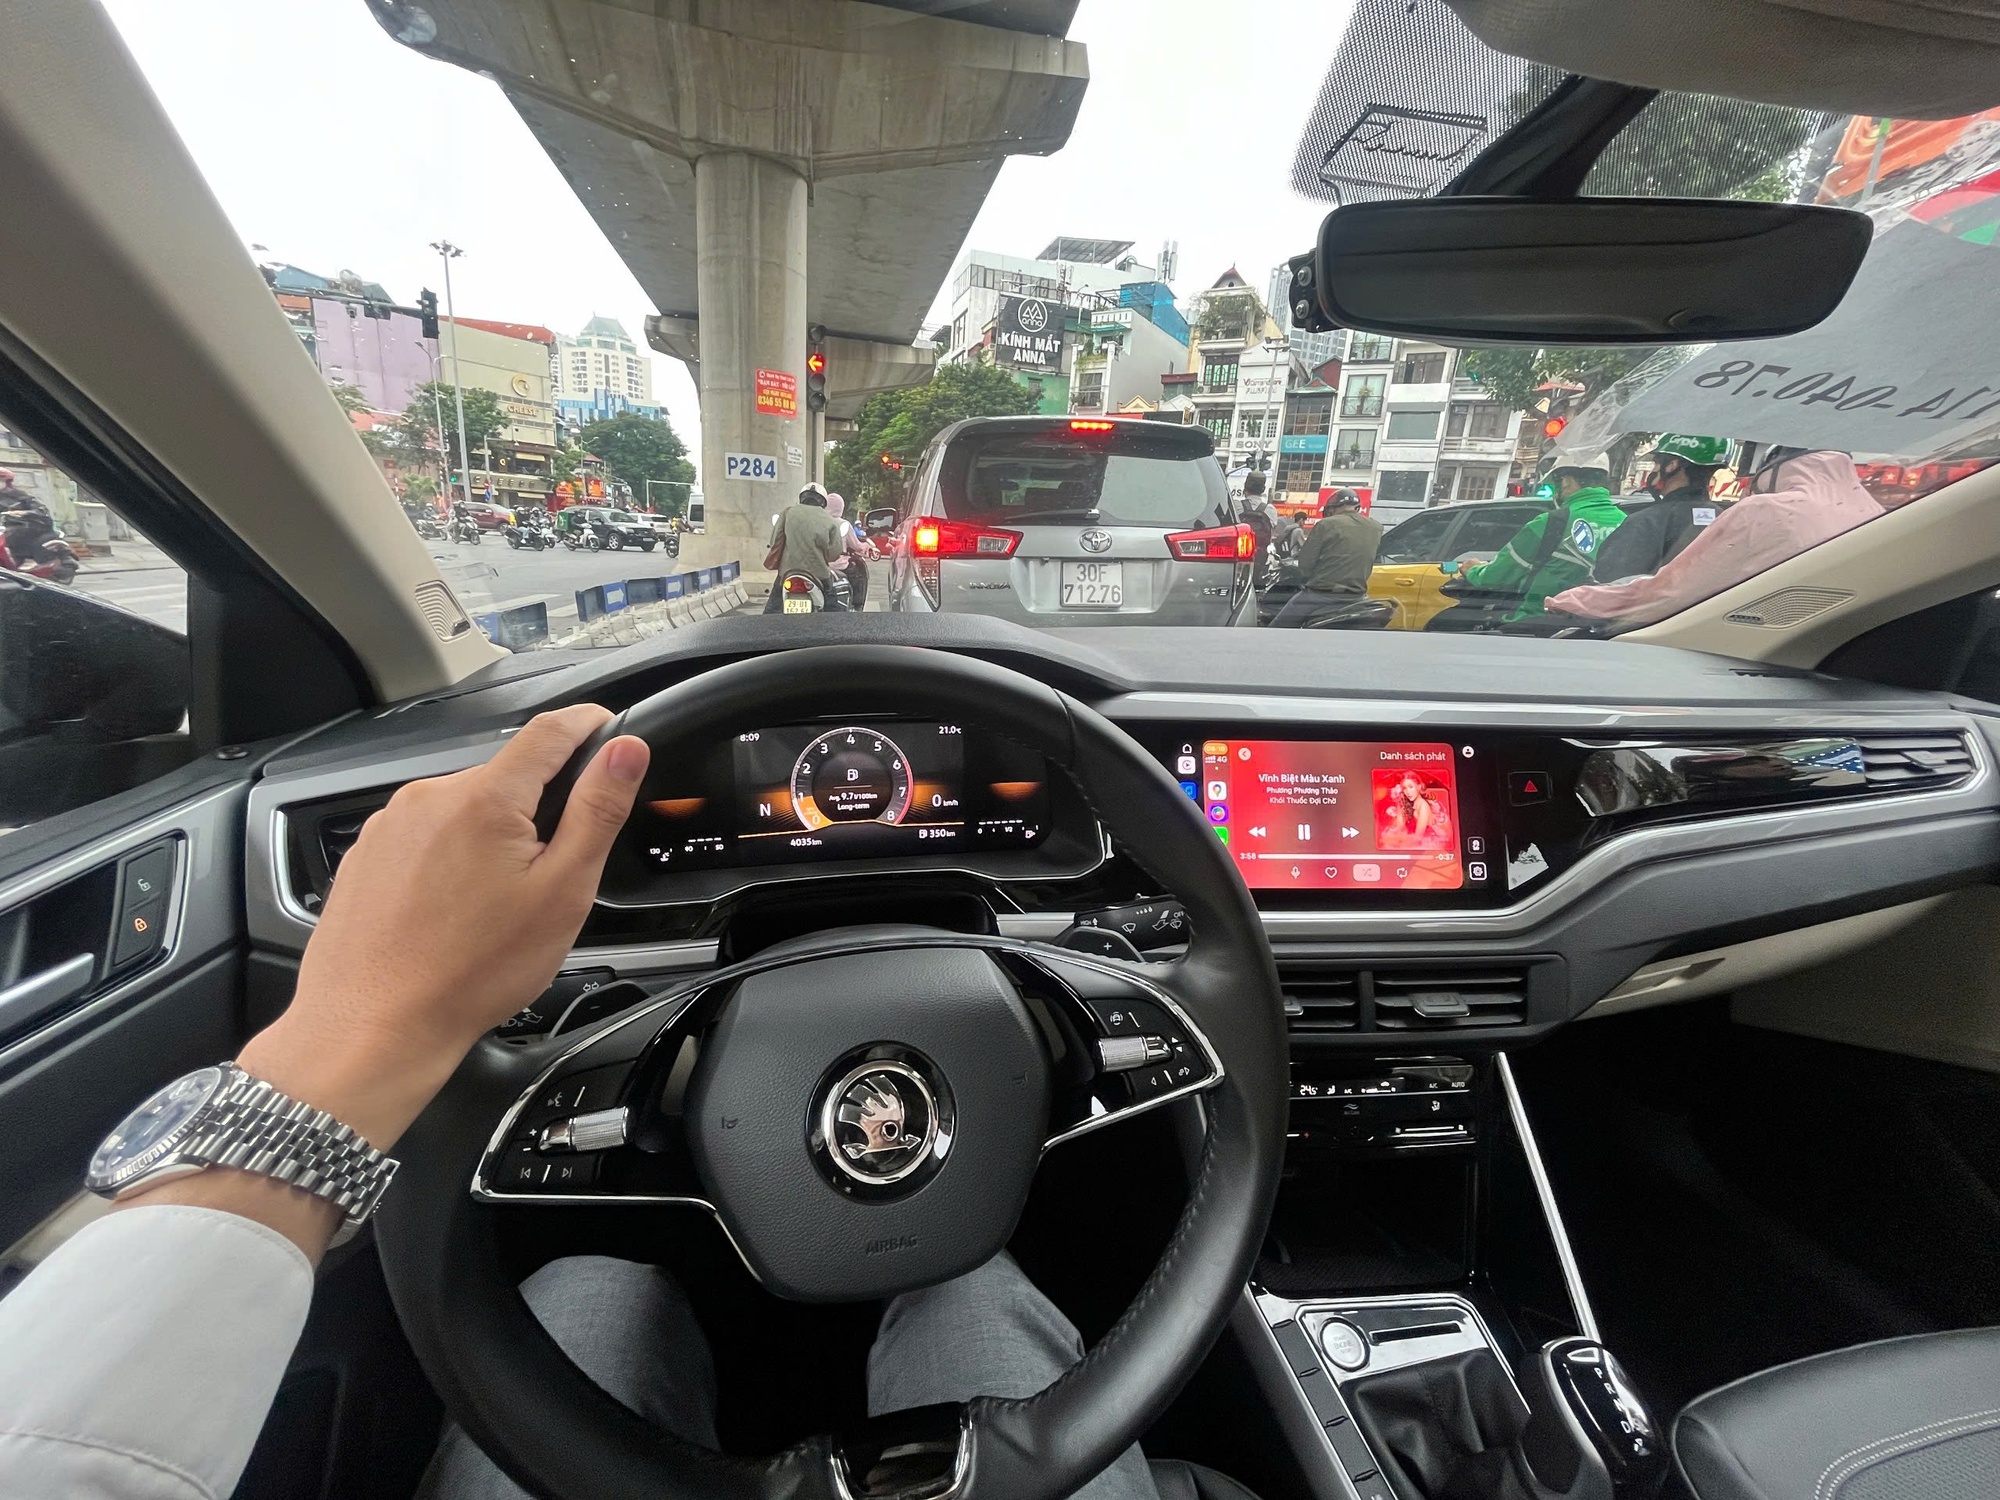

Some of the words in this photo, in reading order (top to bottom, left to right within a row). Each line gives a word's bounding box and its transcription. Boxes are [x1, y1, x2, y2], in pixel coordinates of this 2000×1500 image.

[1001, 330, 1031, 349] KÍNH
[1035, 334, 1061, 353] MẮT
[1013, 349, 1046, 365] ANNA
[1236, 441, 1272, 449] SONY
[1669, 433, 1699, 448] Grab
[727, 456, 776, 478] P284
[1076, 563, 1107, 584] 30F
[1064, 584, 1121, 604] 712.76
[740, 733, 760, 742] 8:09
[847, 735, 855, 744] 4
[820, 743, 829, 753] 3
[874, 741, 882, 752] 5
[1380, 751, 1403, 761] Danh
[1404, 750, 1425, 761] sách
[1426, 750, 1447, 763] phát
[802, 763, 811, 774] 2
[892, 759, 902, 770] 6
[1258, 773, 1279, 783] Vĩnh
[1281, 773, 1299, 785] Biệt
[1300, 773, 1320, 783] Màu
[1321, 774, 1346, 783] Xanh
[798, 792, 804, 802] 1
[899, 787, 907, 798] 7
[932, 794, 942, 807] 0
[759, 803, 771, 817] N
[812, 815, 821, 825] 0
[887, 811, 895, 822] 8
[866, 1235, 919, 1255] AIRBAG
[1593, 1367, 1603, 1379] P
[1603, 1382, 1616, 1395] R
